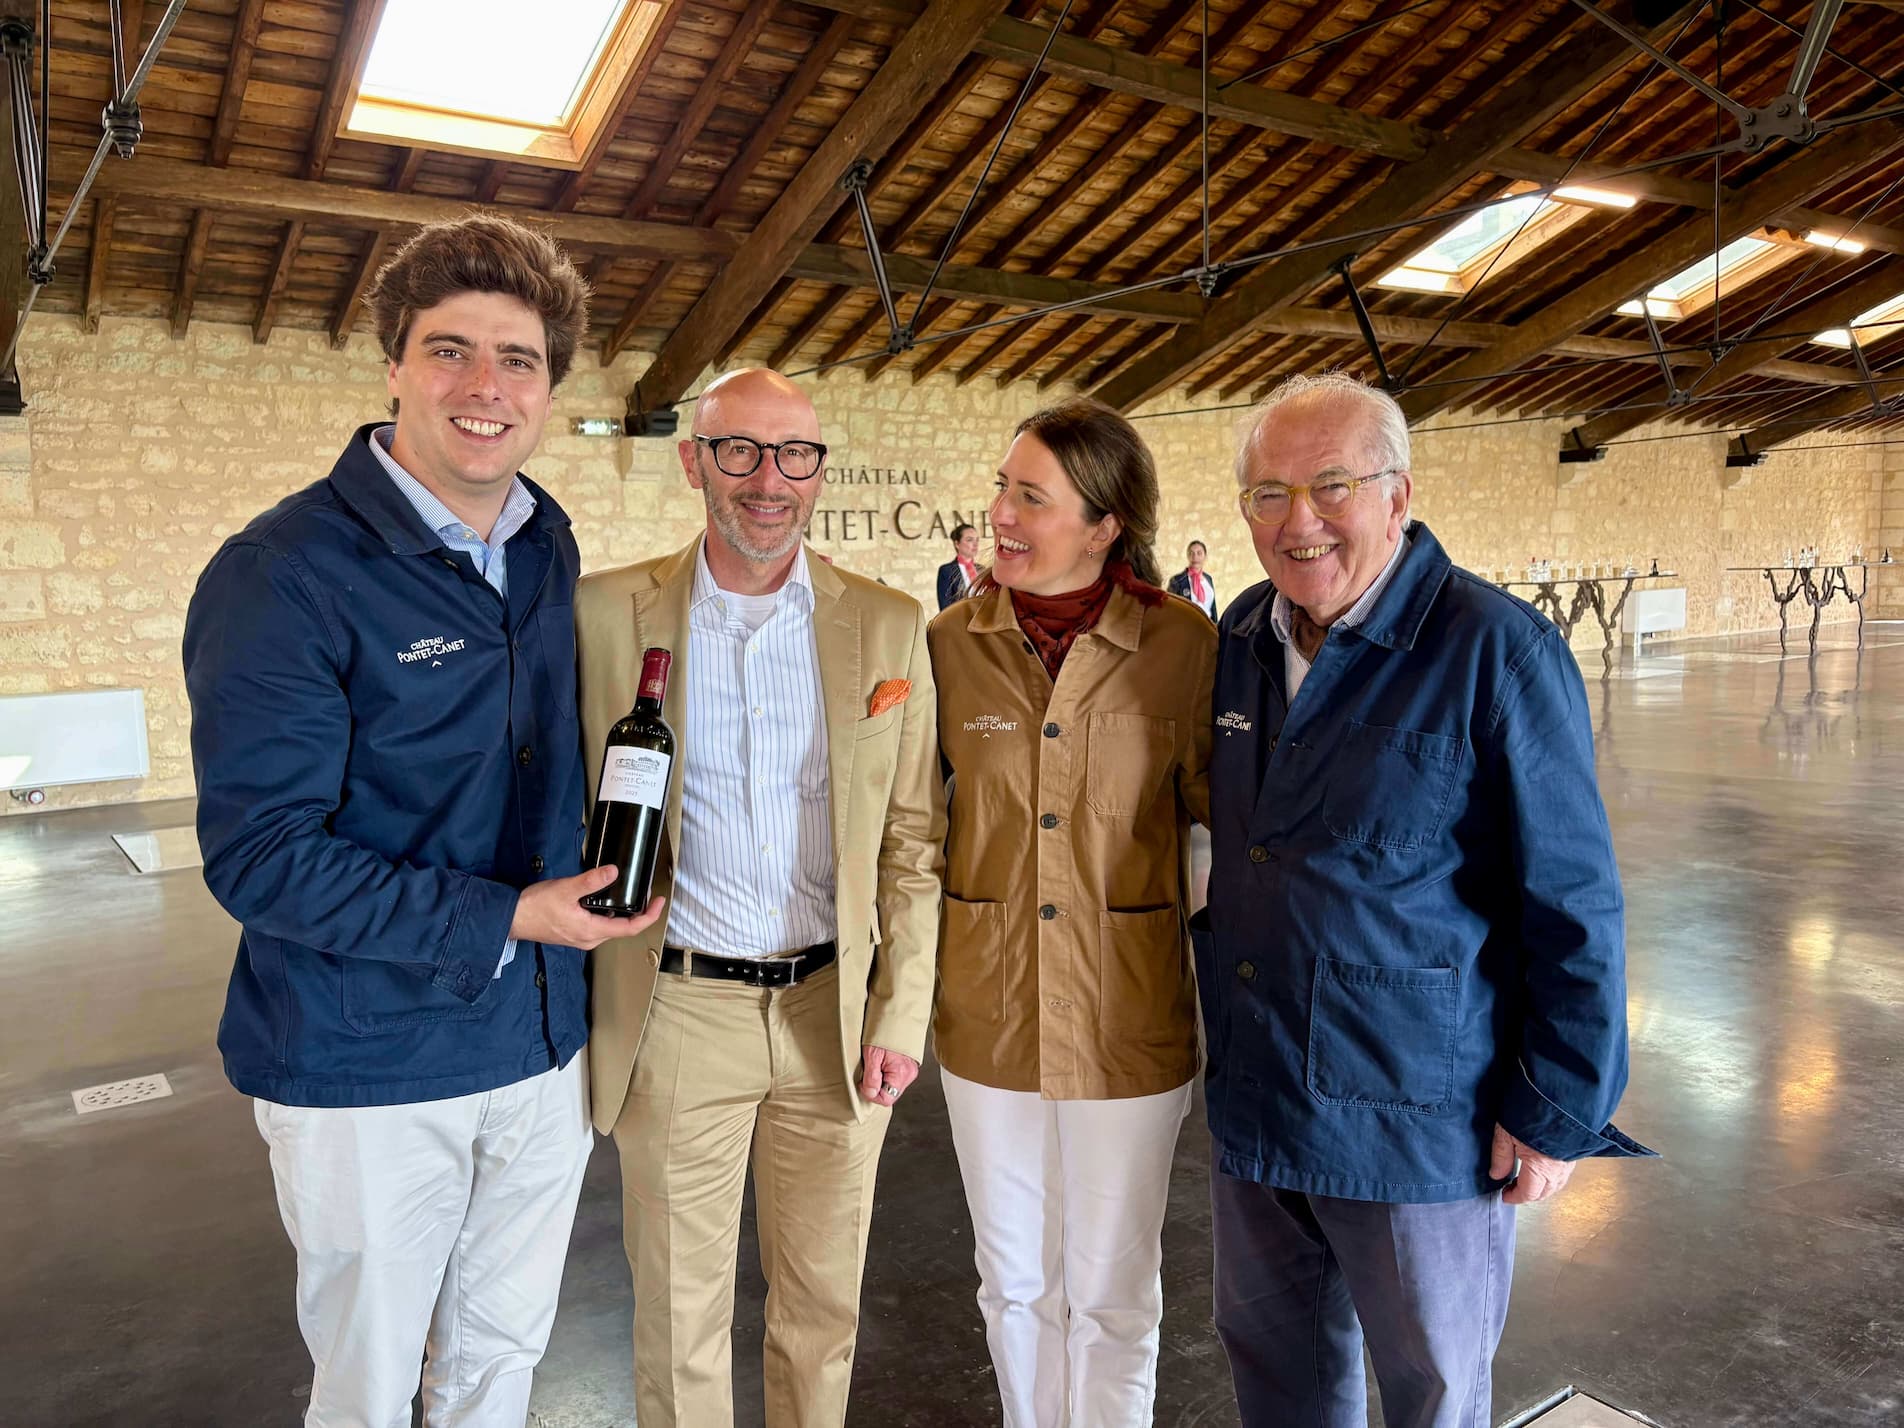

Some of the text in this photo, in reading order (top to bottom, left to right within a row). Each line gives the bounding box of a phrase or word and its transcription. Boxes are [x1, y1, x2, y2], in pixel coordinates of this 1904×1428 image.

[824, 465, 927, 485] CHÂTEAU
[397, 639, 465, 663] PONTET-CANET
[410, 636, 444, 650] CHÂTEAU
[963, 721, 1018, 731] PONTET-CANET
